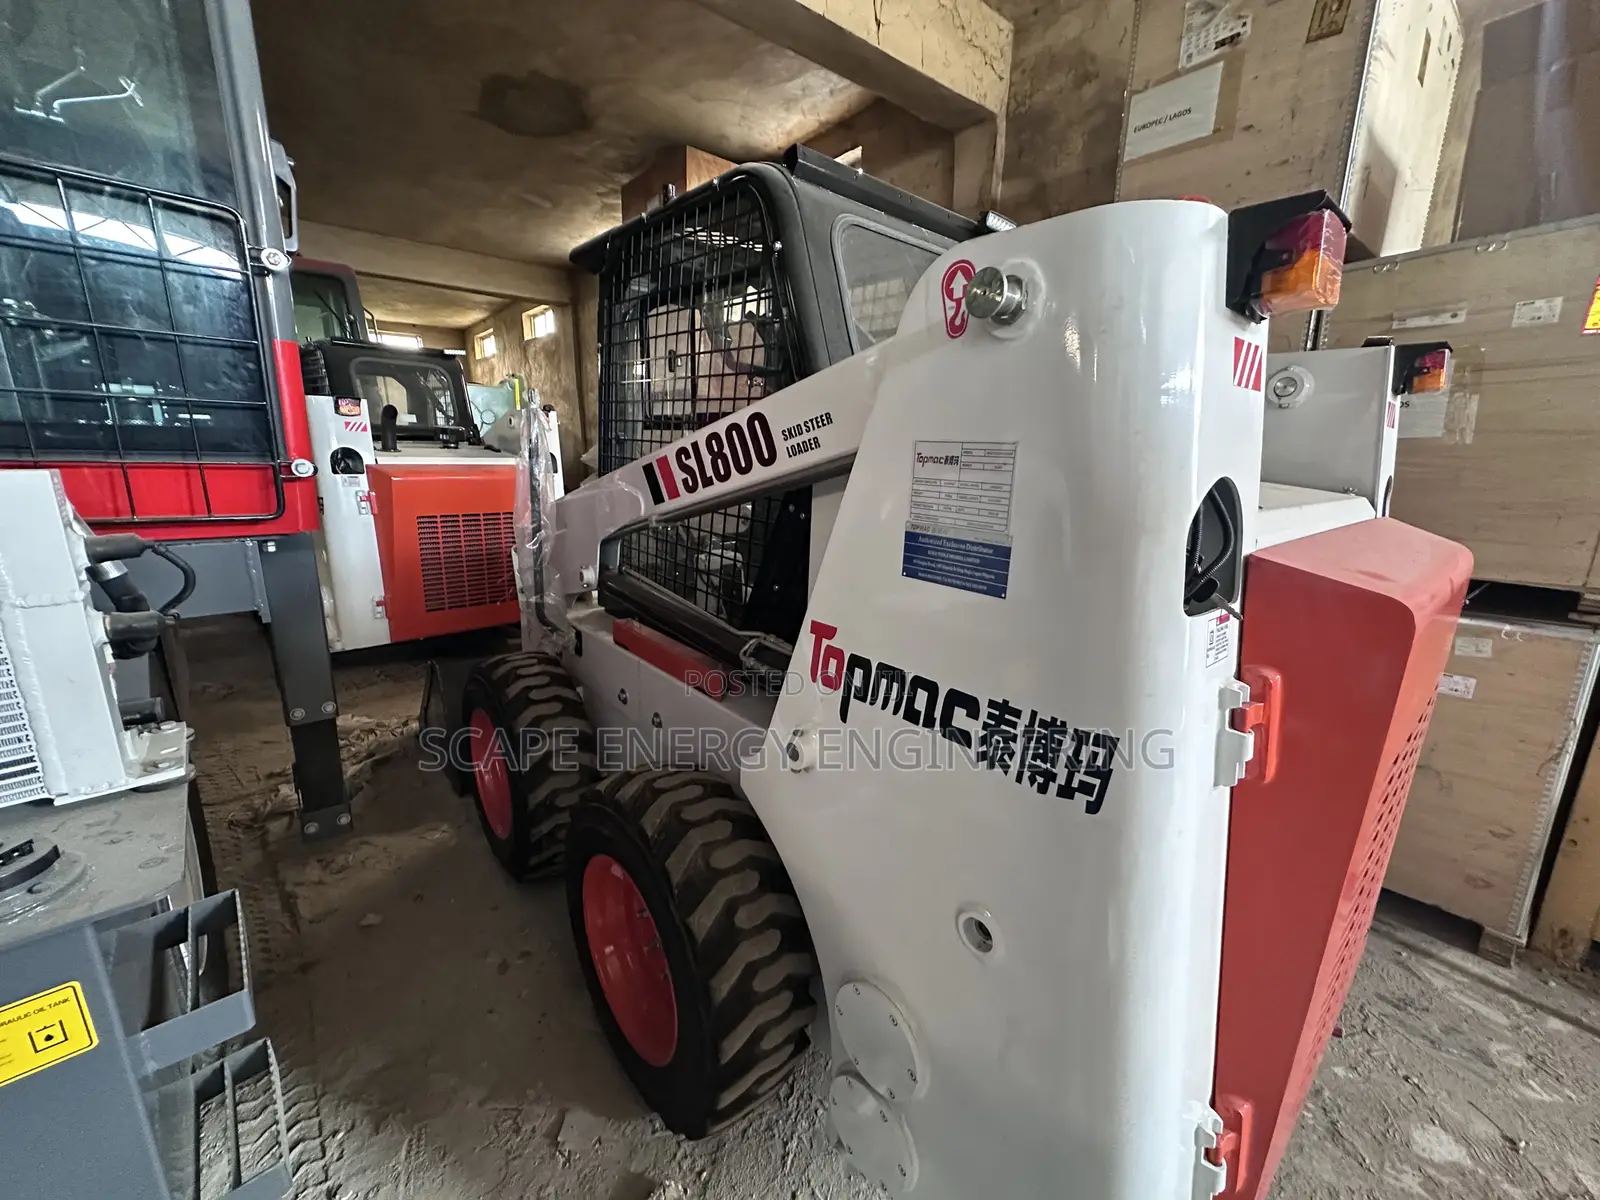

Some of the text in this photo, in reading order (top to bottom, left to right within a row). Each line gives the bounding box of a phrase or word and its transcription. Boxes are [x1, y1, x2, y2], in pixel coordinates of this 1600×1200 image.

[1133, 117, 1163, 134] EUROPEC
[1169, 107, 1192, 121] LAGOS
[781, 411, 834, 442] SKID STEER
[675, 411, 778, 495] SL800
[786, 436, 821, 459] LOADER
[33, 1005, 47, 1015] OIL
[48, 996, 71, 1010] TANK
